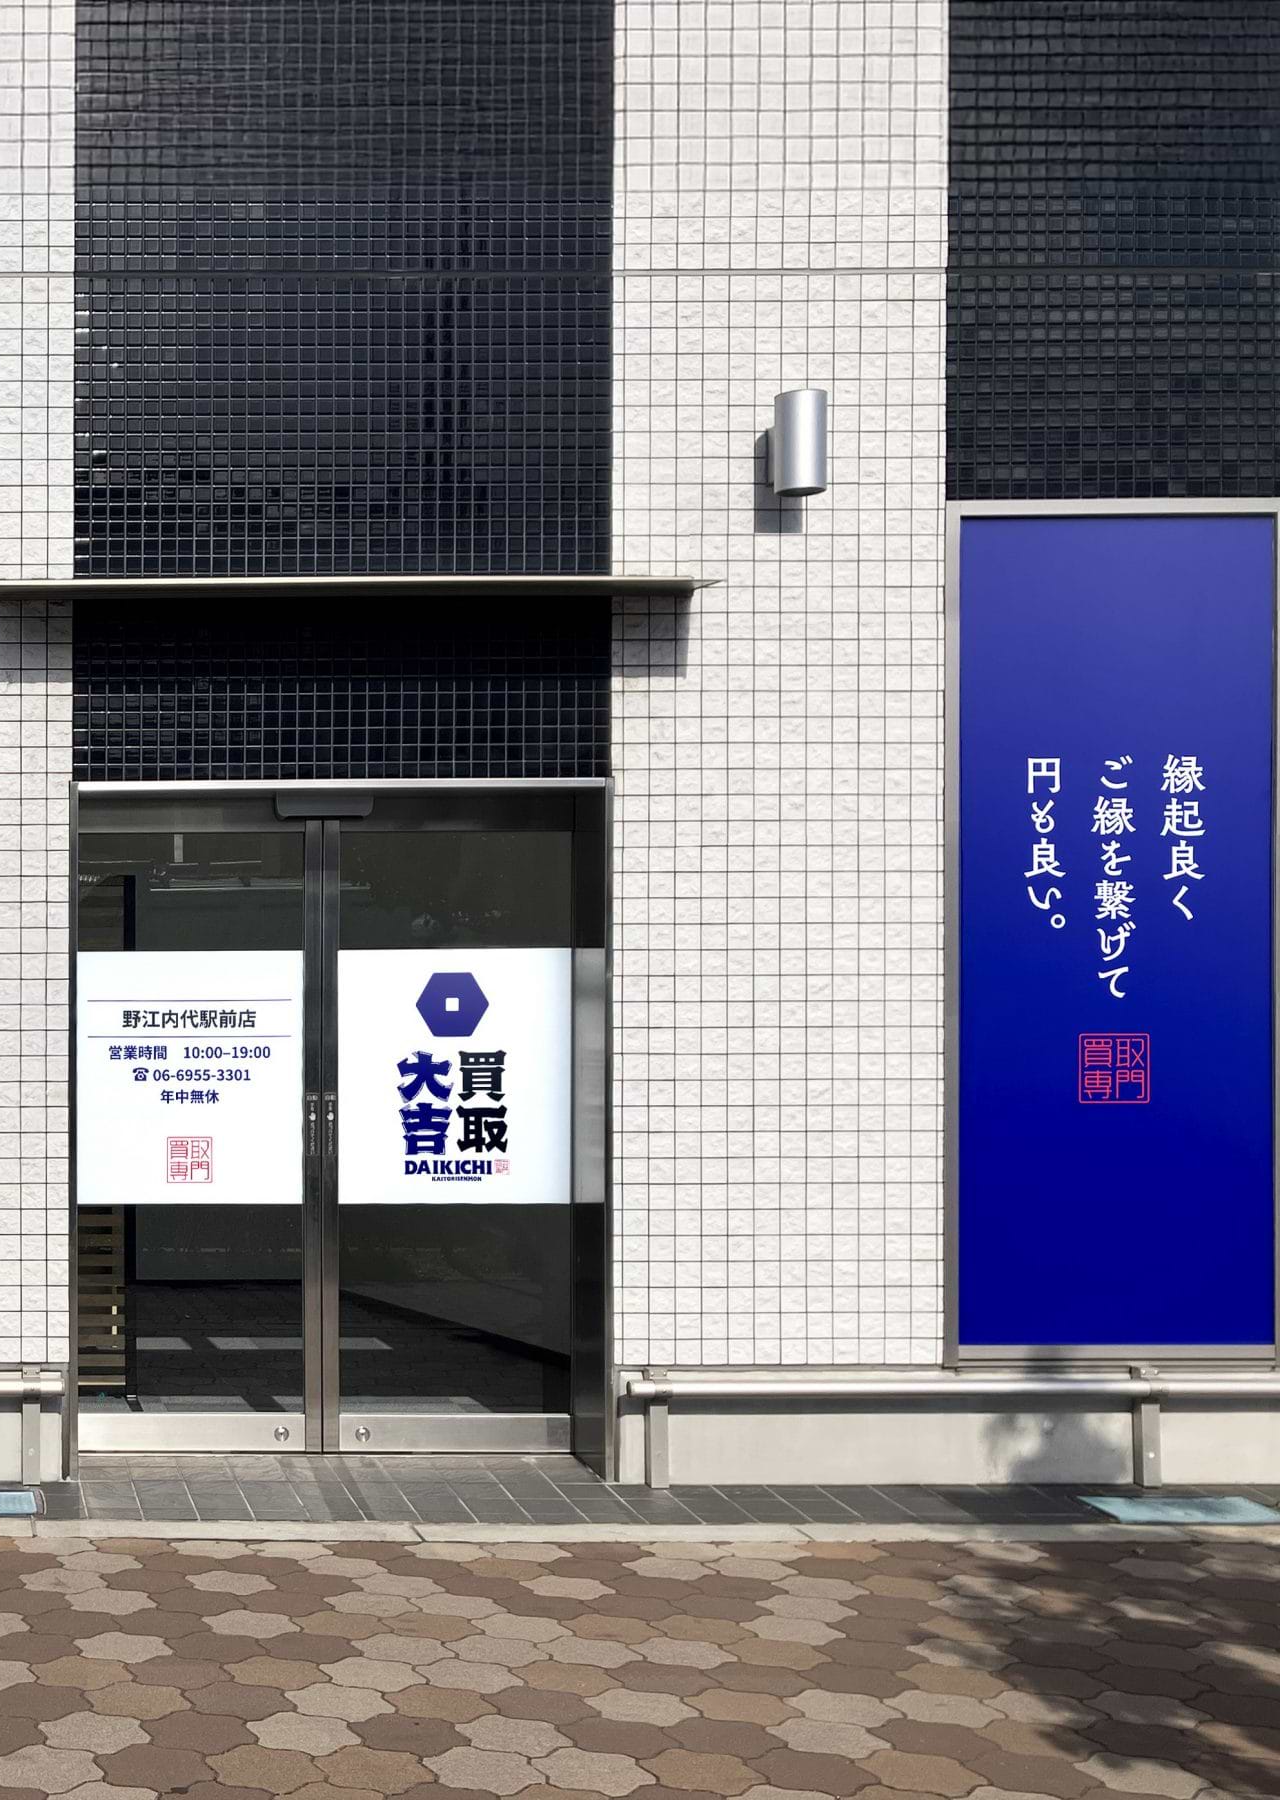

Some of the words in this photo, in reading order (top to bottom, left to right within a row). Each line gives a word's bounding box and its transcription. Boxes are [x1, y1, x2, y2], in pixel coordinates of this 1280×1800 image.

[1023, 757, 1067, 929] 円も良い。
[1159, 753, 1207, 921] 縁起良く
[1091, 754, 1137, 999] ご縁を繋げて
[122, 1009, 257, 1029] 野江内代駅前店
[108, 1045, 168, 1060] 営業時間
[152, 1068, 251, 1081] 06-6955-3301
[160, 1089, 220, 1104] 年中無休
[404, 1159, 493, 1176] DAIKICHI
